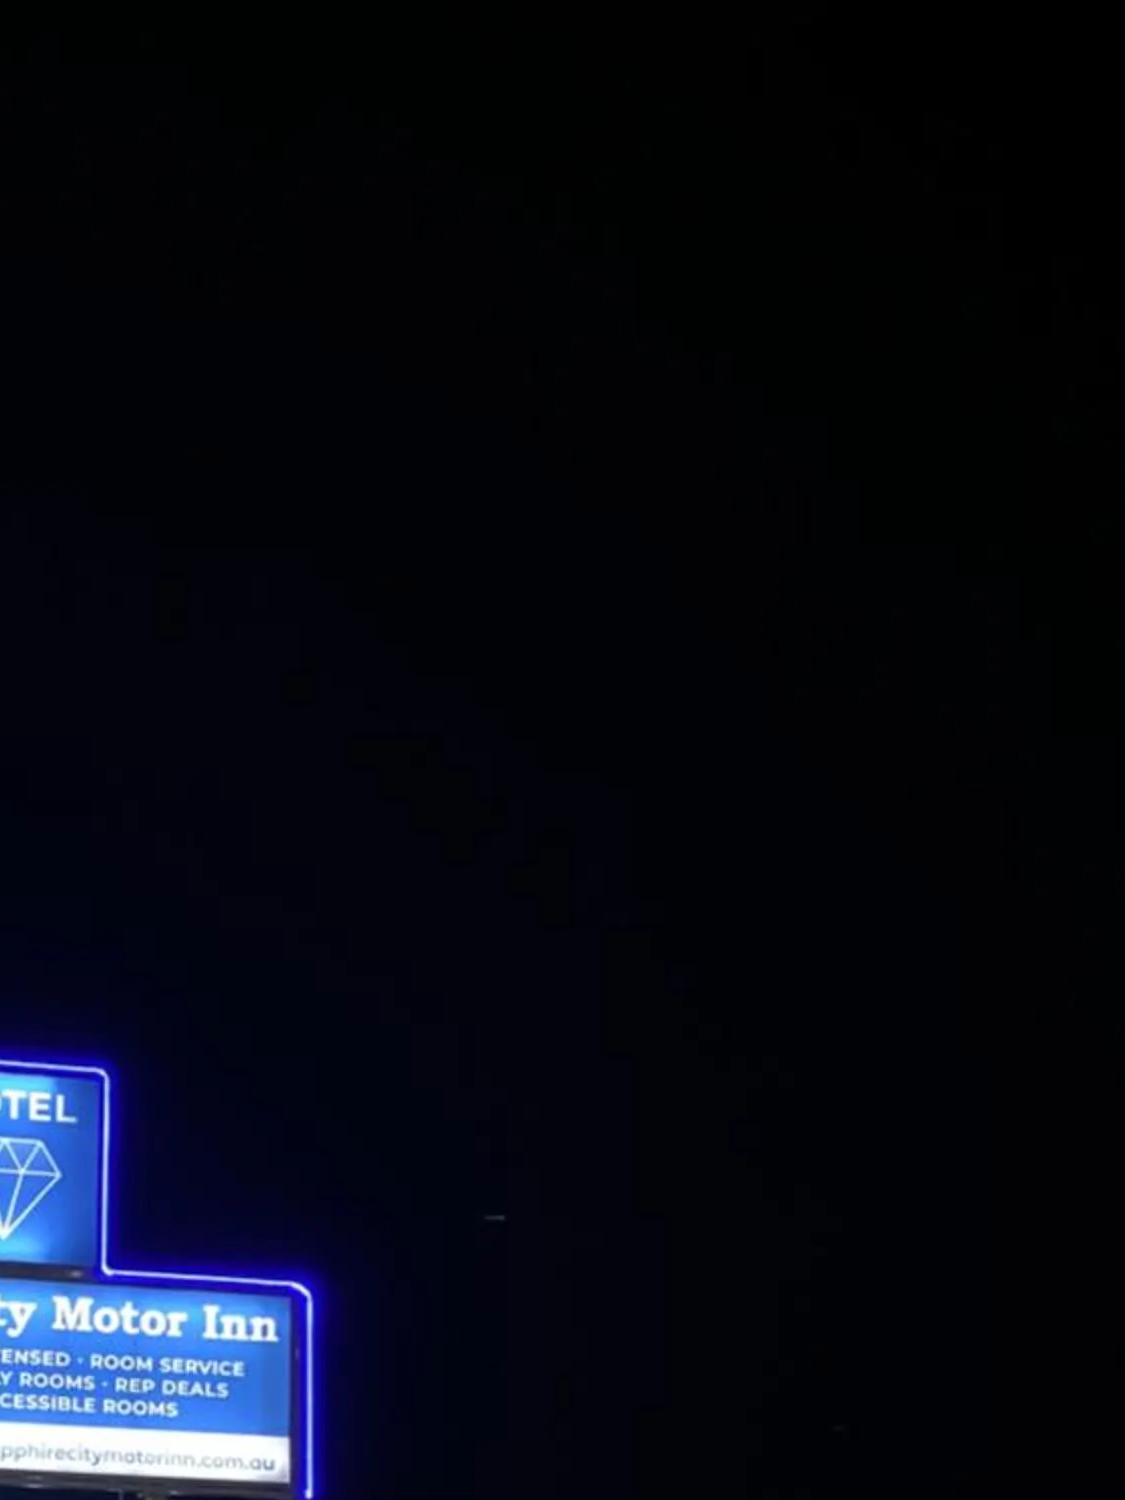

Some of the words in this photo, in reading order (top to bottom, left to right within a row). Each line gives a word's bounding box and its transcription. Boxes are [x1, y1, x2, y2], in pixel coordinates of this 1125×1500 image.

[51, 1295, 188, 1337] Motor
[202, 1304, 279, 1343] Inn
[90, 1354, 153, 1371] ROOM
[159, 1357, 245, 1377] SERVICE
[19, 1372, 95, 1391] ROOMS
[115, 1378, 155, 1393] REP
[162, 1380, 229, 1398] DEALS
[103, 1399, 178, 1418] ROOMS
